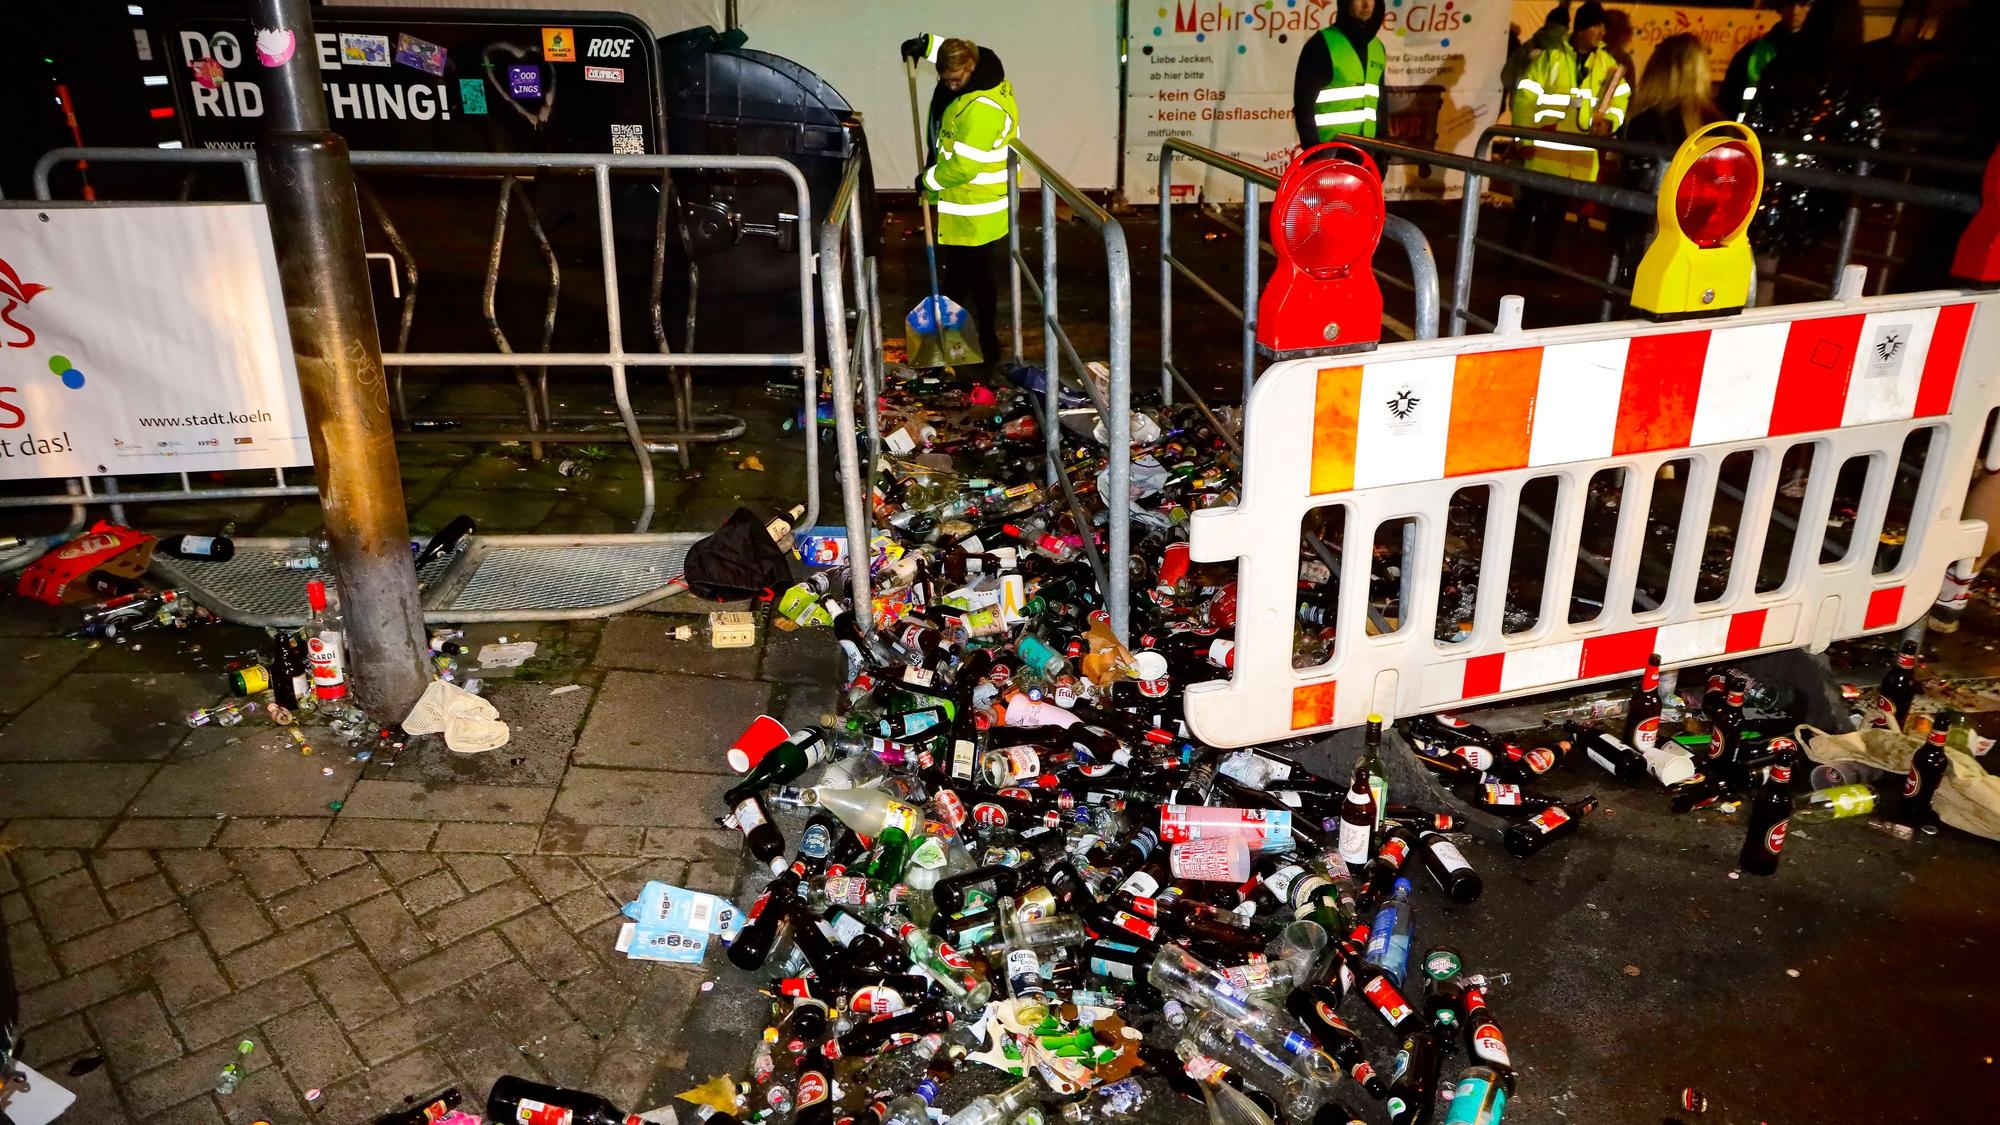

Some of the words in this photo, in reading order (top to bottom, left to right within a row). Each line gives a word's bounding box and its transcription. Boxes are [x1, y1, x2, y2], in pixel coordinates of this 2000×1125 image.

[1175, 0, 1245, 33] Mehr
[1252, 4, 1320, 39] Spaß
[1406, 4, 1461, 33] Glas
[587, 38, 635, 58] ROSE
[1150, 54, 1176, 64] Liebe
[1178, 54, 1214, 65] Jecken,
[1150, 71, 1162, 81] ab
[1164, 71, 1181, 80] hier
[1184, 71, 1205, 80] bitte
[1158, 89, 1189, 102] kein
[1193, 88, 1226, 101] Glas
[1157, 109, 1197, 121] keine
[1201, 107, 1295, 121] Glasflaschen
[1146, 153, 1160, 162] Zu
[138, 410, 272, 428] www.stadt.koeln
[20, 431, 73, 457] das!
